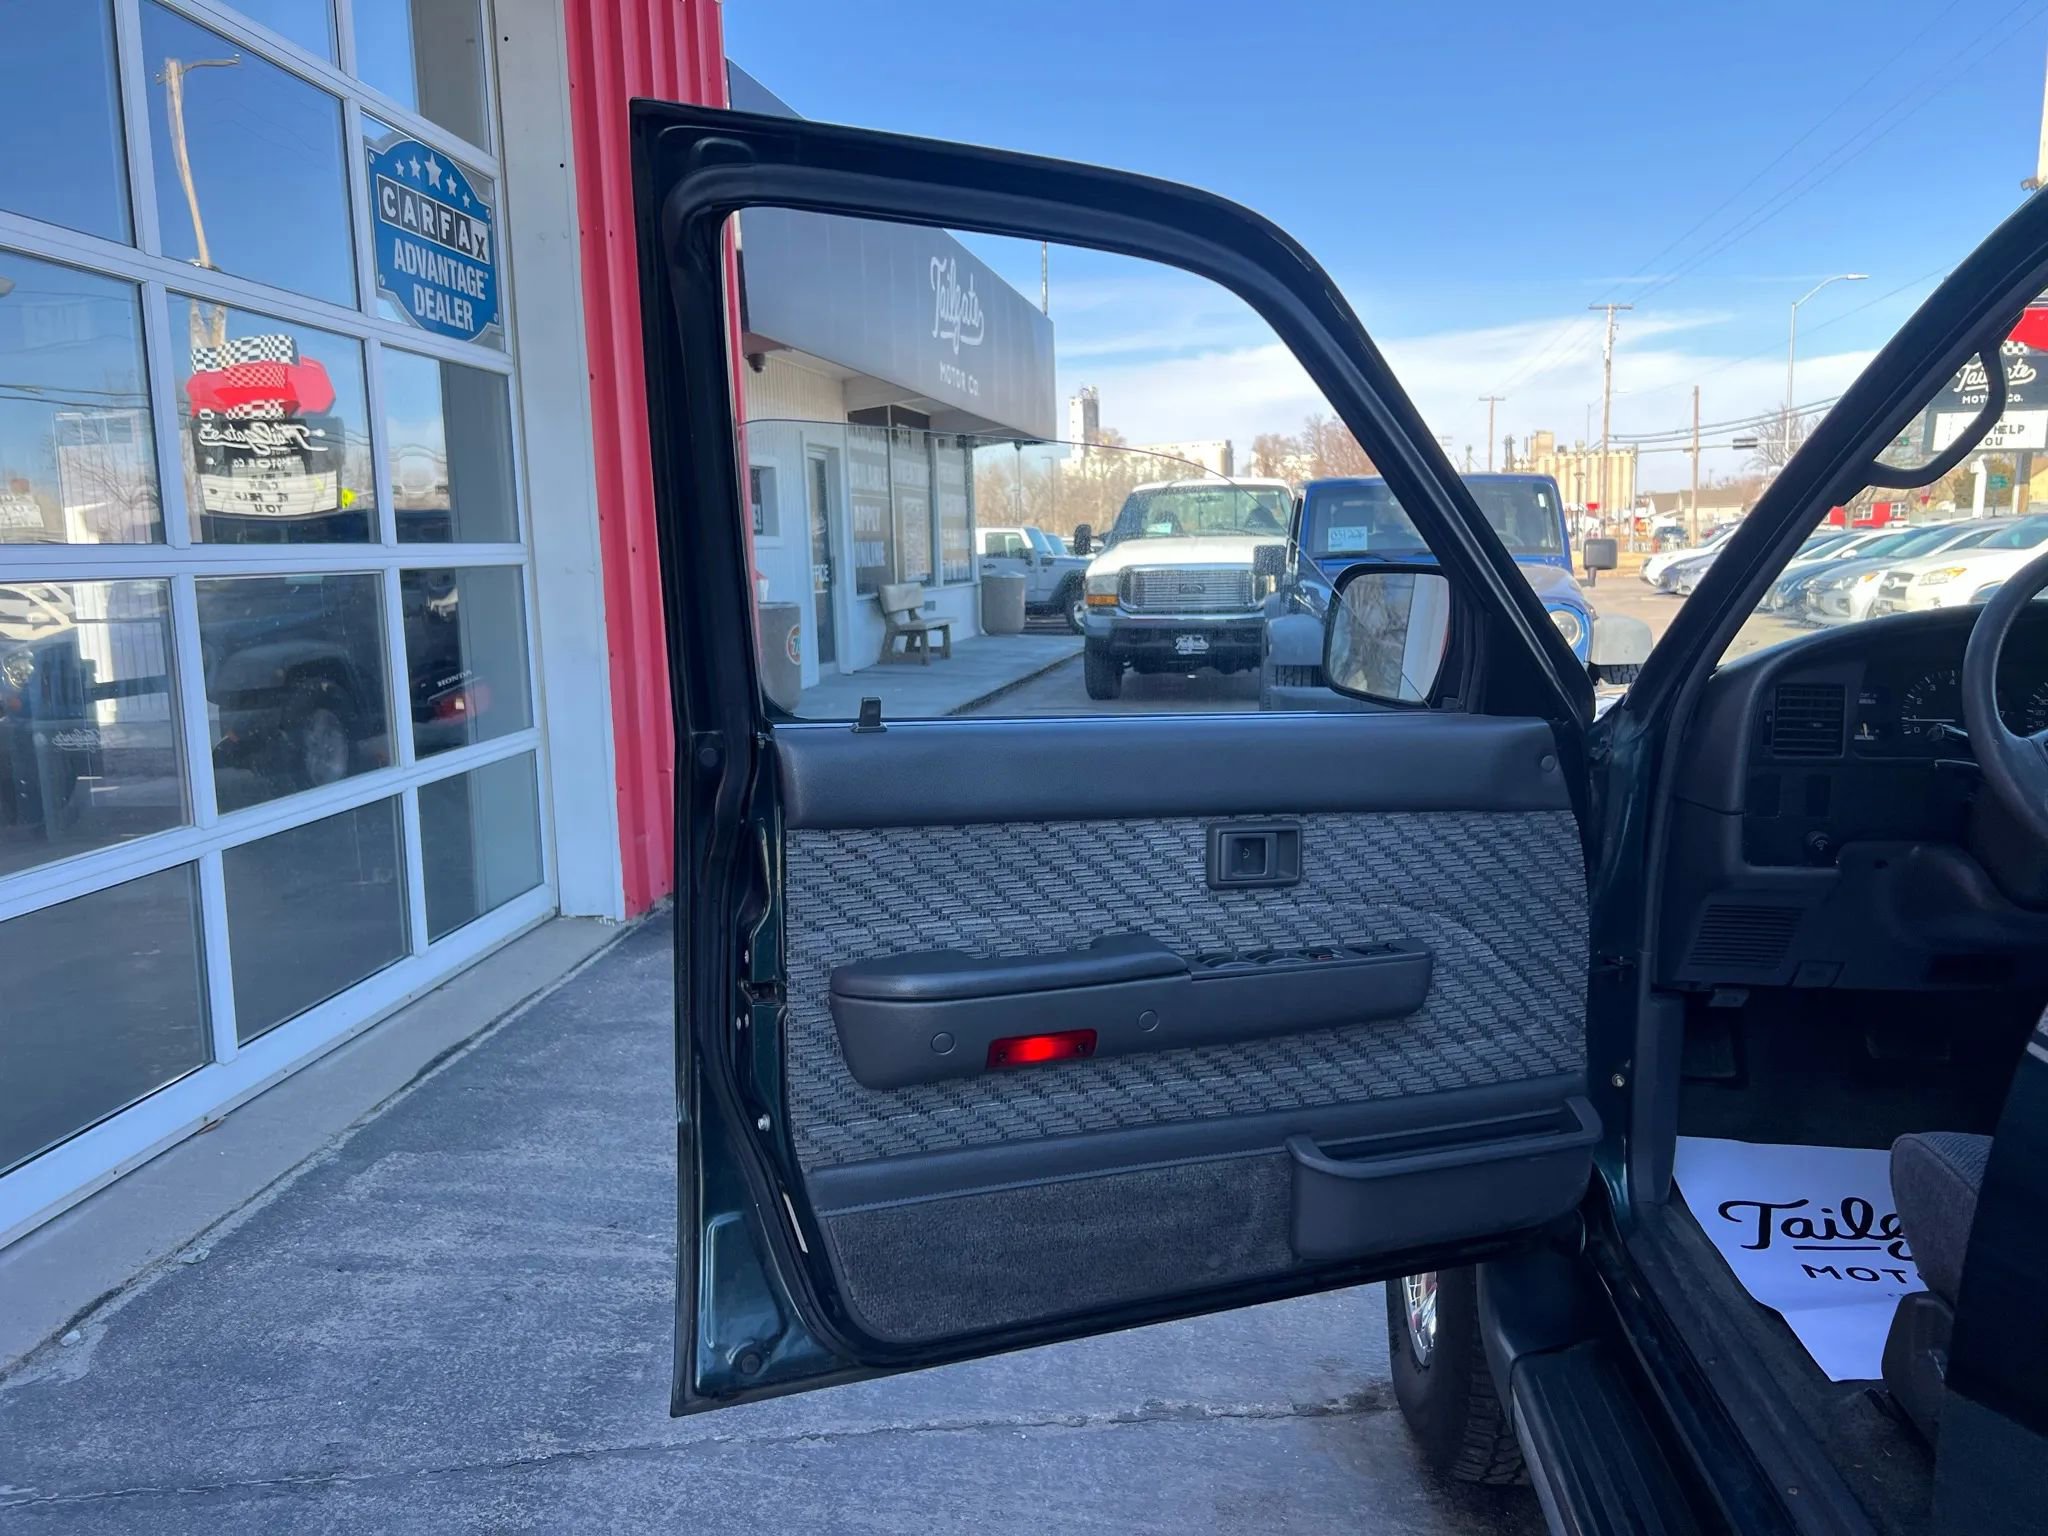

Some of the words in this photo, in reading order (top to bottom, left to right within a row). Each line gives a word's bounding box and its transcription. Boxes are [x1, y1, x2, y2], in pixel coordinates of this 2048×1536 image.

[381, 185, 487, 261] CARFAX
[394, 238, 486, 300] ADVANTAGE
[413, 283, 475, 331] DEALER
[930, 256, 985, 355] Tailgate
[939, 360, 967, 392] MOTOR
[1962, 394, 1988, 404] MOT
[1984, 437, 2003, 446] OU
[1993, 425, 2025, 435] HELP
[436, 670, 472, 687] HONDA
[1801, 1264, 1921, 1284] MOT
